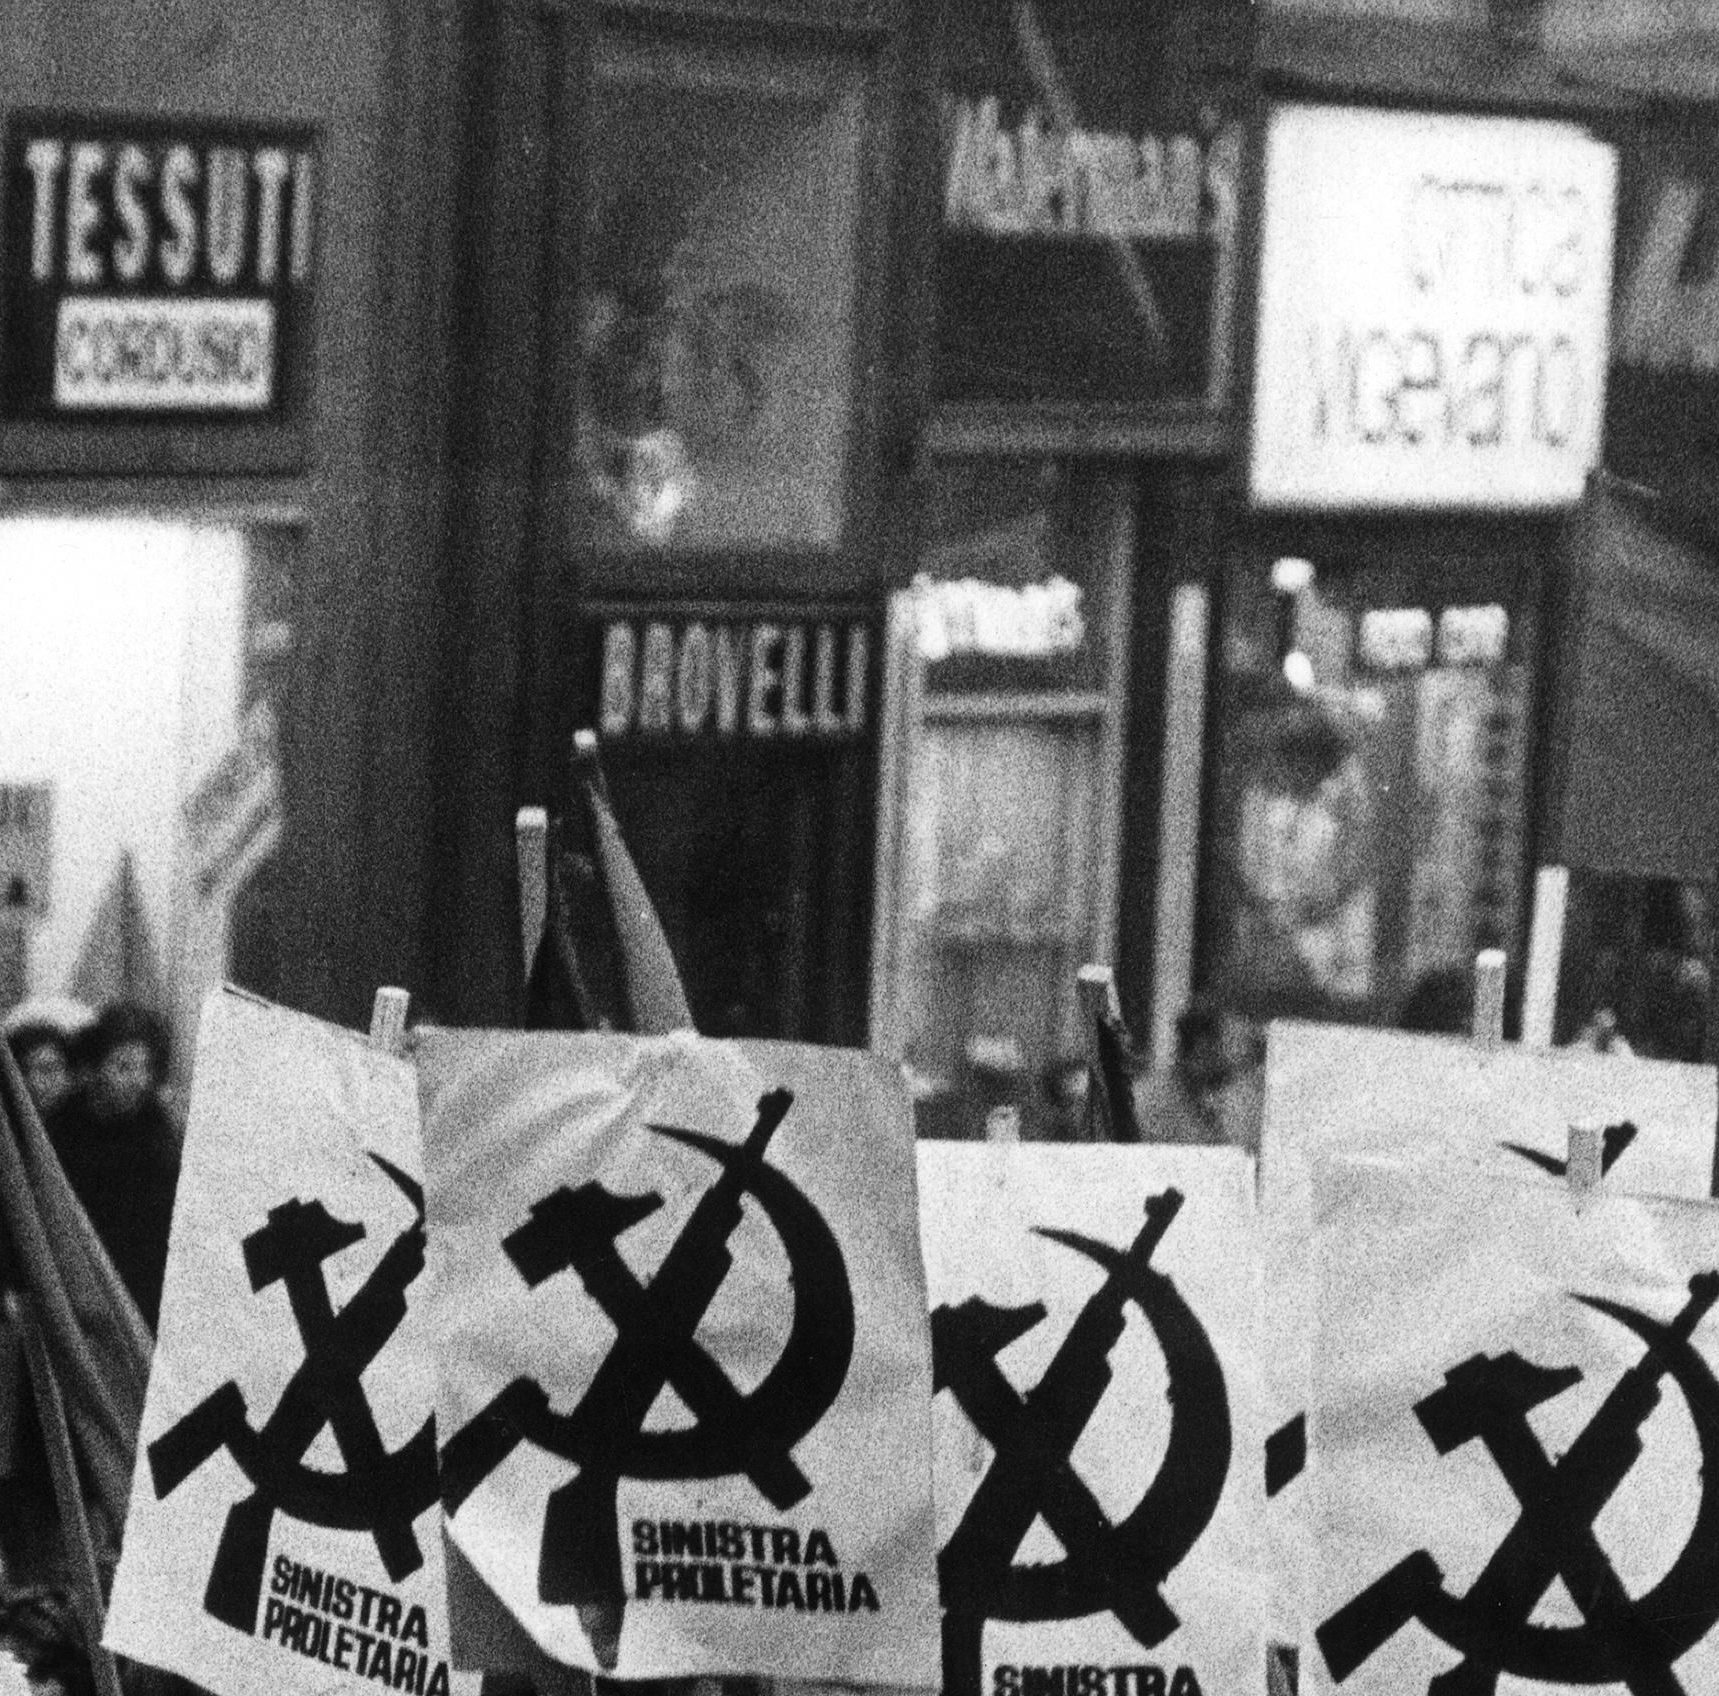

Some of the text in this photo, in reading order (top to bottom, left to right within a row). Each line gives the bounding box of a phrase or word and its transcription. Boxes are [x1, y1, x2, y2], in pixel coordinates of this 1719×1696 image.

[25, 139, 313, 285] TESSUTI
[601, 621, 868, 735] BROVELLI
[632, 1520, 838, 1567] SINISTRA
[635, 1562, 881, 1615] PROLETARIA
[271, 1555, 429, 1648] SINISTRA
